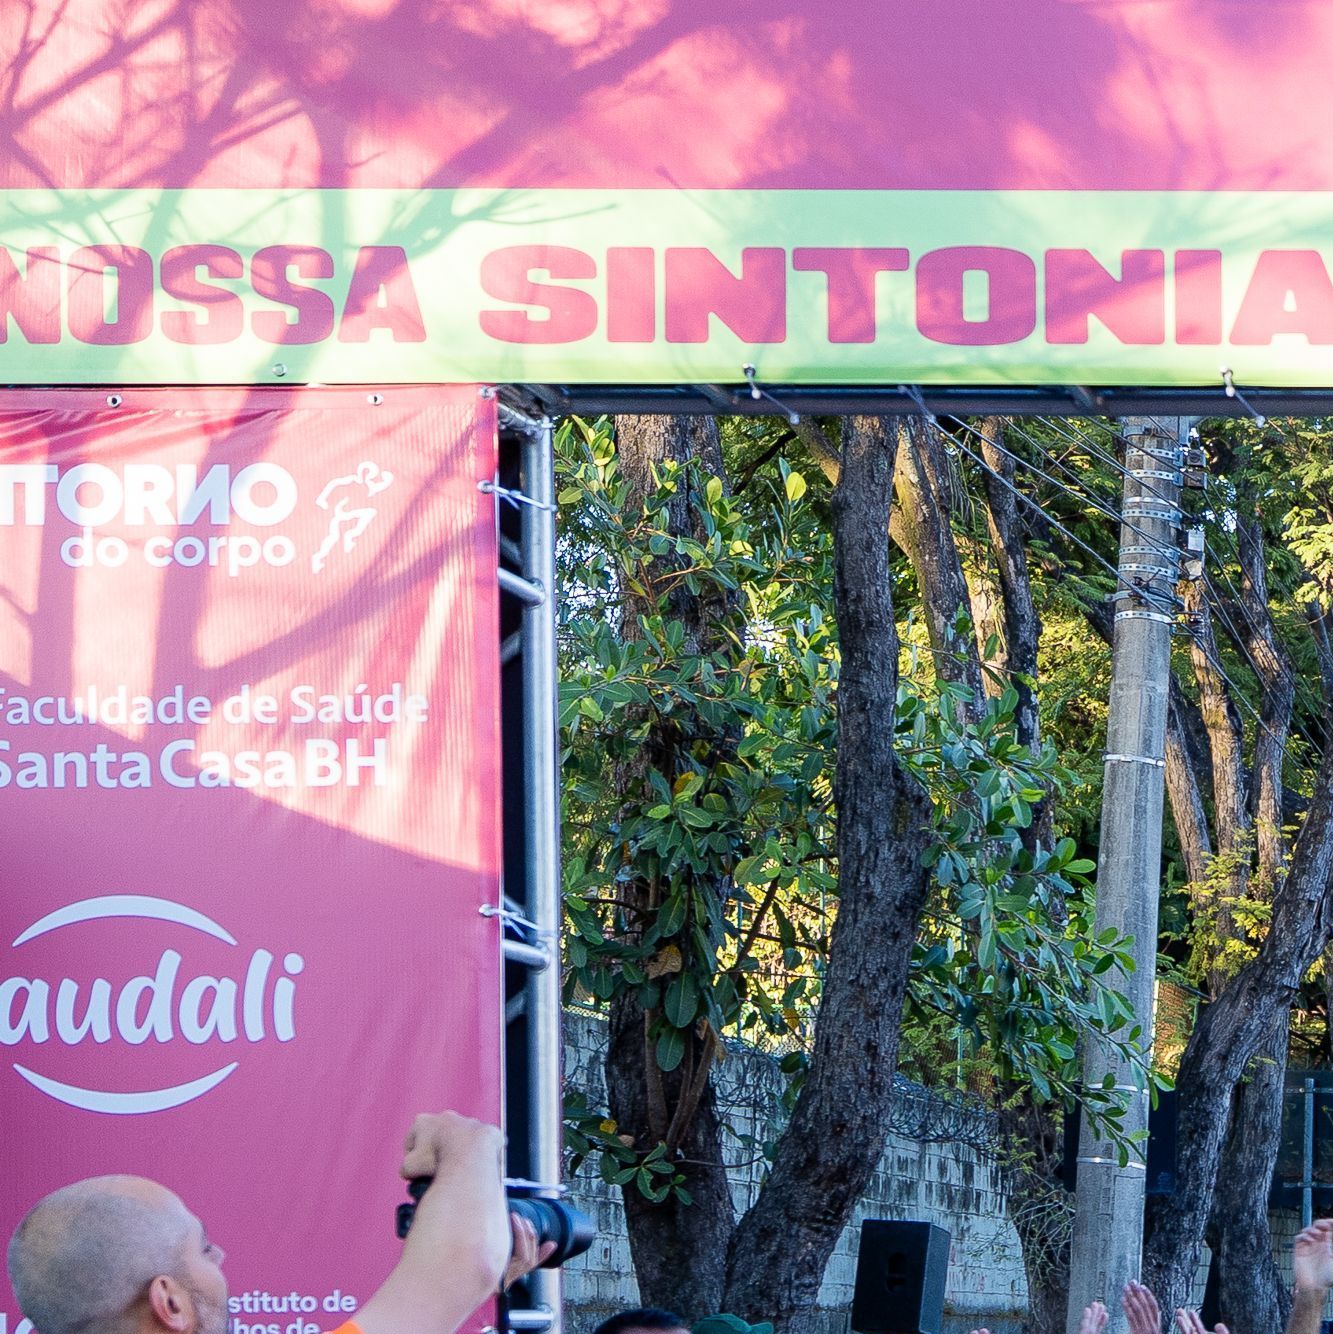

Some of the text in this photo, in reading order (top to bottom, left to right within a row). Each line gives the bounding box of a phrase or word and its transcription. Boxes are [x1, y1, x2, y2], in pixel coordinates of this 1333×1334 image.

[0, 245, 427, 345] NOSSA
[60, 526, 297, 577] do corpo
[222, 684, 279, 724] de
[290, 683, 429, 724] Saúde
[0, 948, 305, 1045] audali
[322, 1289, 357, 1313] de
